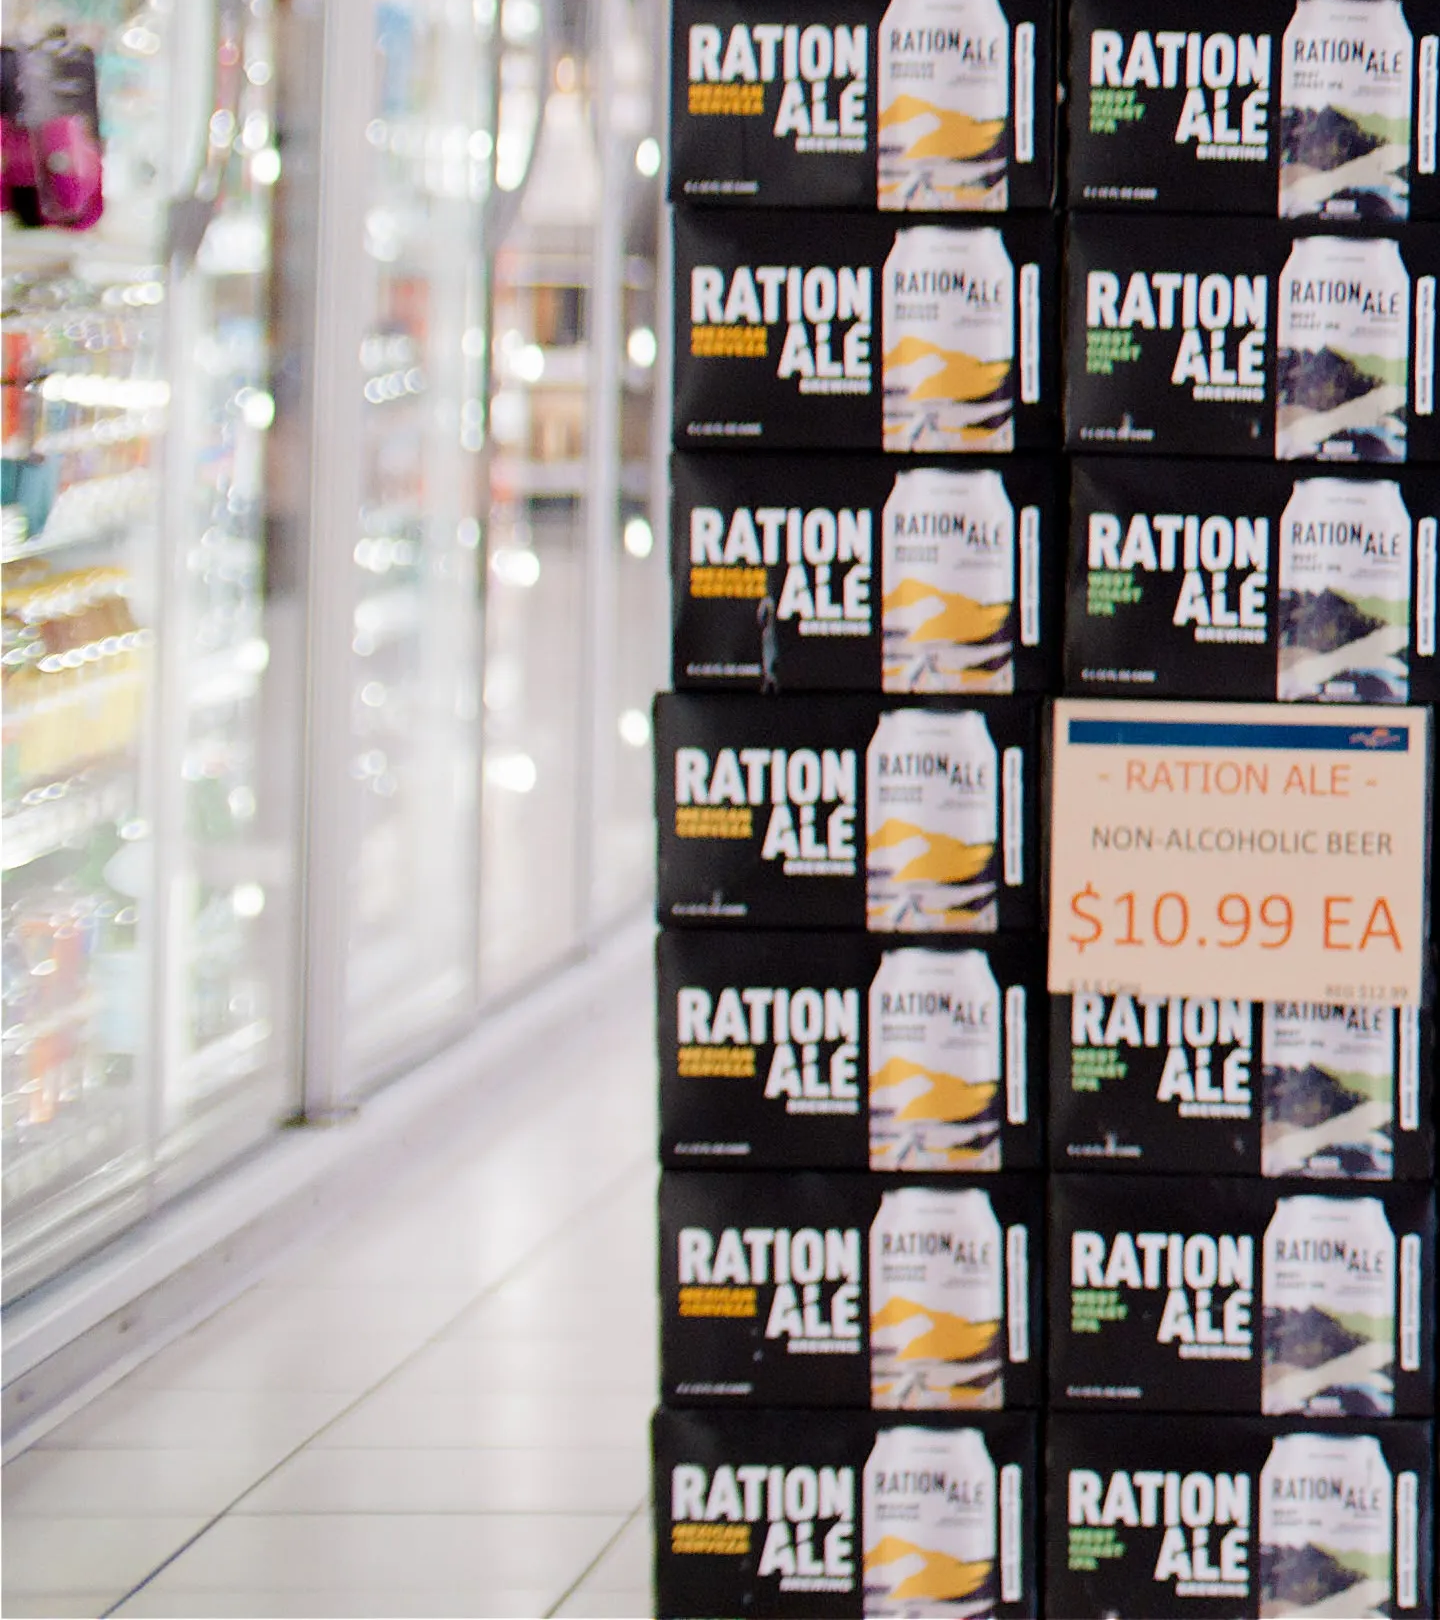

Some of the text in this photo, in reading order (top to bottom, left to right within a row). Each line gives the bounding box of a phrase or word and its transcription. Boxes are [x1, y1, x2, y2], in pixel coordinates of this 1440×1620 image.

[688, 23, 869, 82] RATION
[1089, 29, 1272, 88] RATION
[773, 79, 868, 138] ALE
[1174, 87, 1270, 144] ALE
[691, 265, 872, 324] RATION
[1085, 270, 1268, 329] RATION
[776, 321, 871, 380] ALE
[1170, 328, 1266, 385] ALE
[691, 506, 872, 565] RATION
[1087, 512, 1270, 571] RATION
[776, 562, 871, 621] ALE
[1172, 570, 1268, 627] ALE
[675, 747, 856, 806] RATION
[1125, 759, 1351, 796] RATION ALE
[760, 803, 855, 862] ALE
[1091, 827, 1393, 855] NON-ALCOHOLIC BEER
[1068, 881, 1402, 954] $10.99 EA
[678, 986, 859, 1045] RATION
[1068, 994, 1251, 1047] RATION
[763, 1042, 858, 1101] ALE
[1155, 1046, 1251, 1103] ALE
[673, 1463, 854, 1522] RATION
[1068, 1468, 1251, 1527] RATION
[758, 1519, 853, 1578] ALE
[1153, 1526, 1249, 1583] ALE
